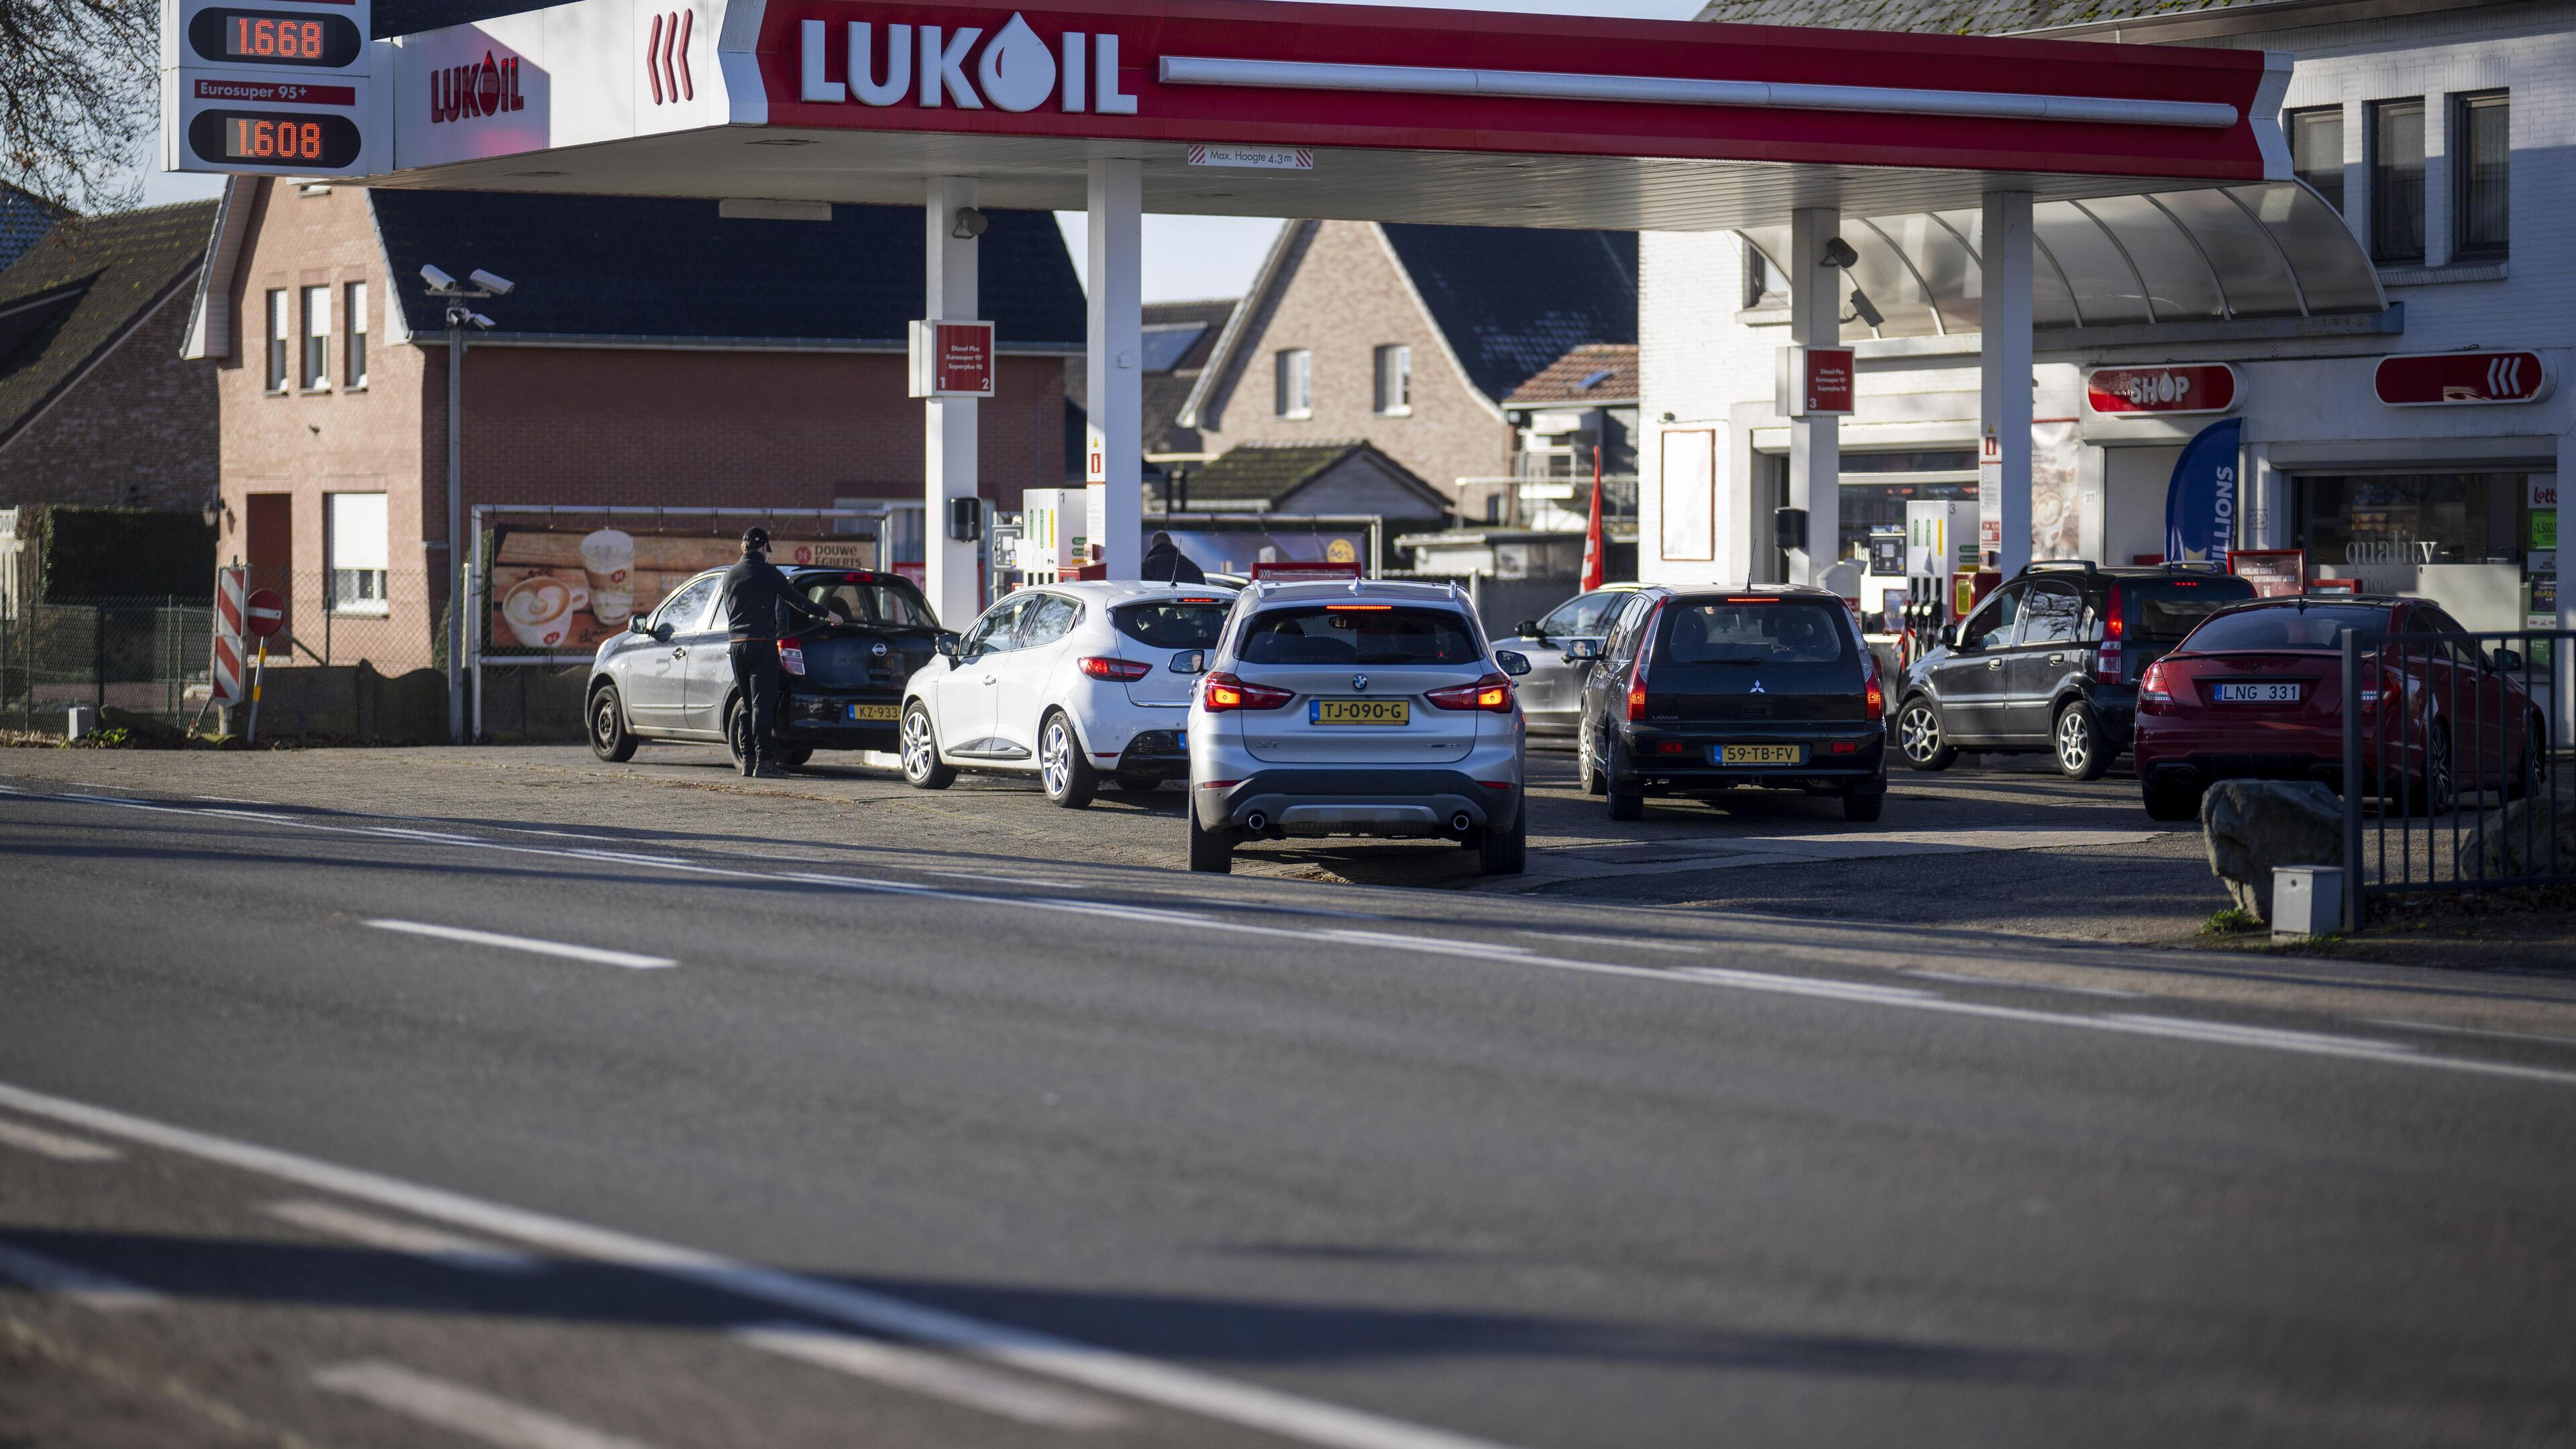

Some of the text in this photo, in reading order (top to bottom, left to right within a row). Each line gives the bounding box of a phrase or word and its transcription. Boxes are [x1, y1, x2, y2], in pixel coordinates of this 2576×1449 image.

[238, 18, 321, 58] 1.668
[801, 11, 1138, 114] LUKOIL
[200, 81, 307, 101] Eurosuper 95+
[431, 50, 524, 123] LUKOIL
[238, 119, 321, 159] 1.608
[1210, 150, 1232, 160] Max.
[1235, 151, 1266, 164] Hoogte
[940, 376, 946, 388] 1
[981, 378, 989, 389] 2
[2129, 368, 2190, 404] SHOP
[1809, 397, 1817, 409] 3
[1060, 492, 1065, 503] 1
[1949, 504, 1955, 515] 3
[2345, 530, 2438, 574] quality
[2223, 686, 2296, 699] LNG 331
[859, 706, 901, 718] KZ-933-
[1324, 703, 1401, 718] TJ-090-G
[1727, 747, 1793, 760] 59-TB-FV
